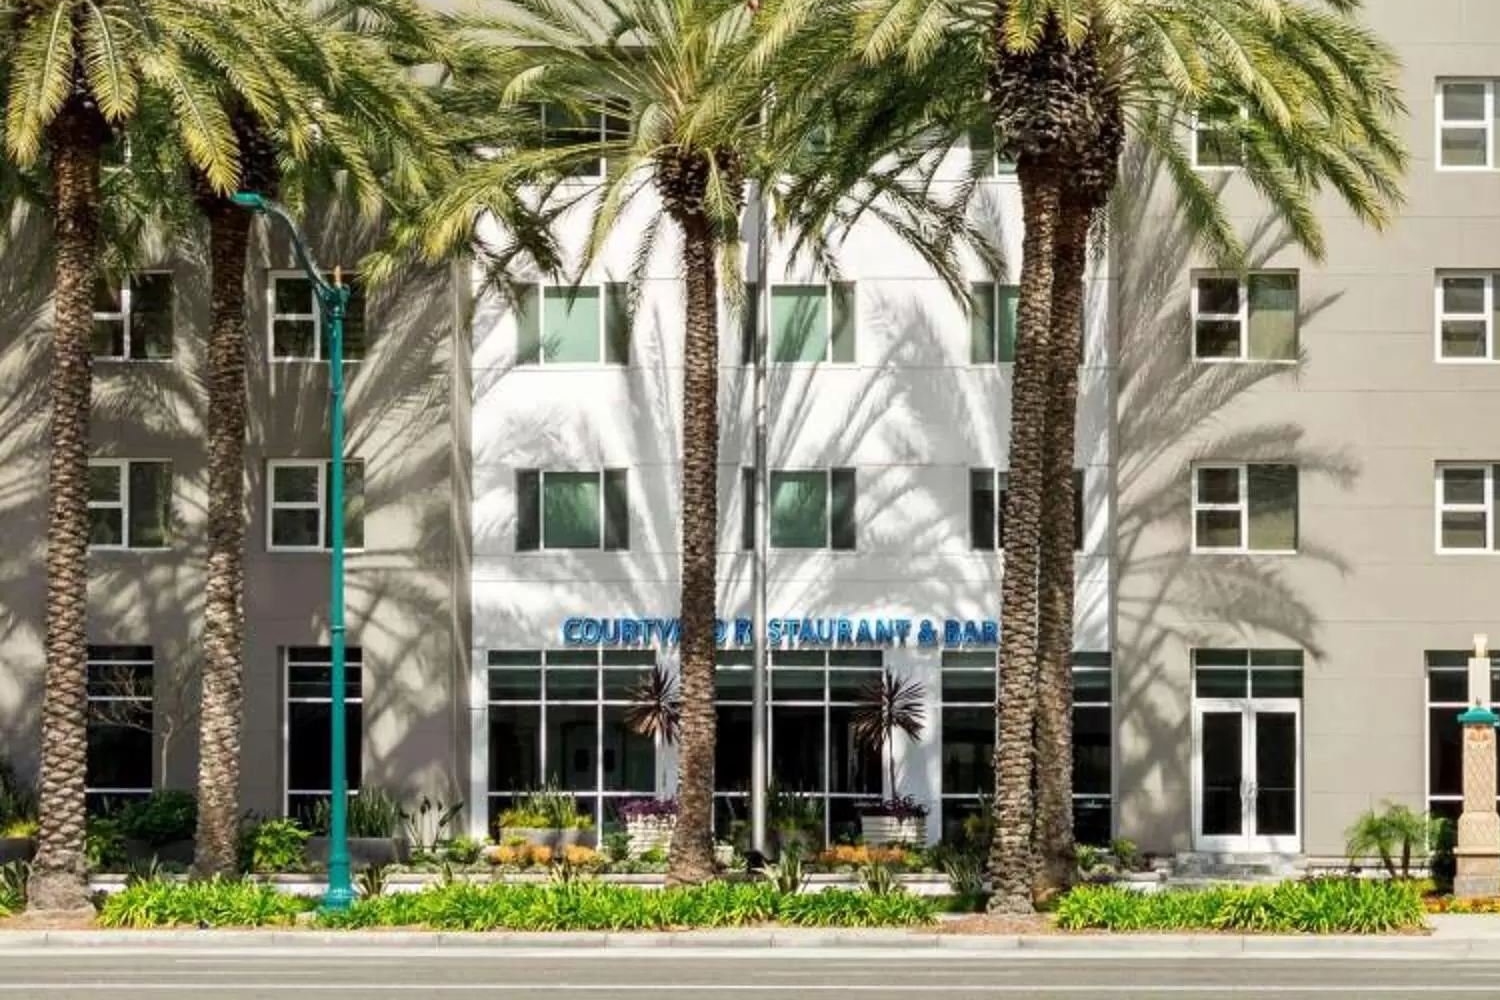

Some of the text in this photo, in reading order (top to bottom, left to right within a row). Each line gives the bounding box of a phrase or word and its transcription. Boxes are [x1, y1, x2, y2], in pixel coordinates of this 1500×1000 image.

[563, 618, 998, 646] COURTYD RSTAURANT & BAR
